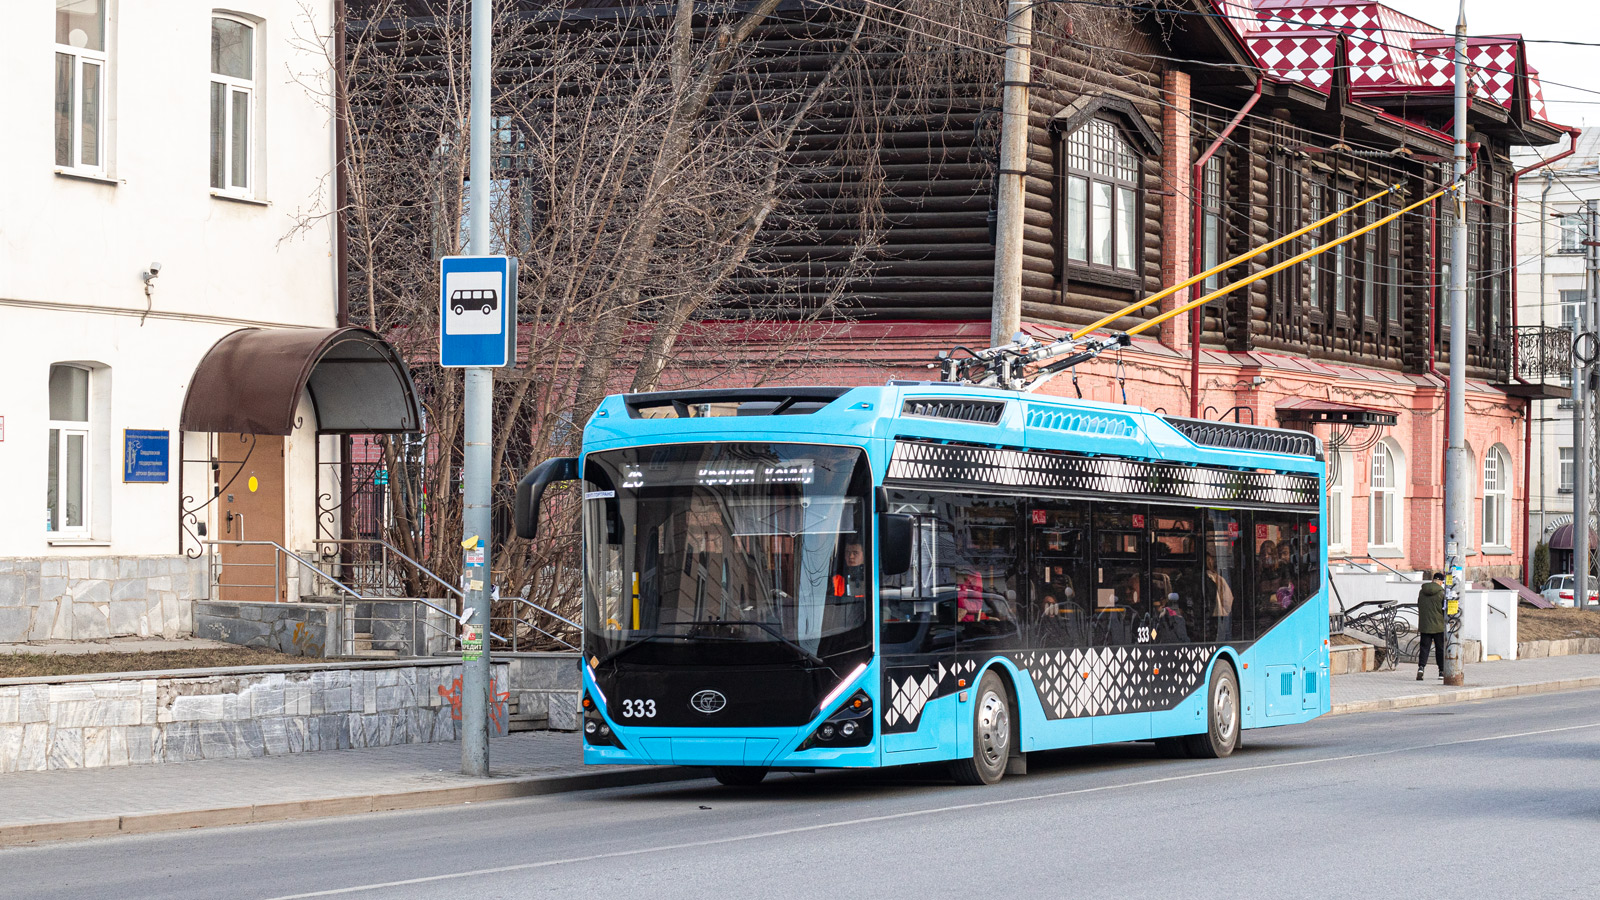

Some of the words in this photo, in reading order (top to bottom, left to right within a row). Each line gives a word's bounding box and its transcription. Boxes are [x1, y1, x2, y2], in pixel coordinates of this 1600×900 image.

[1547, 514, 1571, 531] SHOW
[1137, 626, 1150, 643] 333
[622, 699, 657, 718] 333
